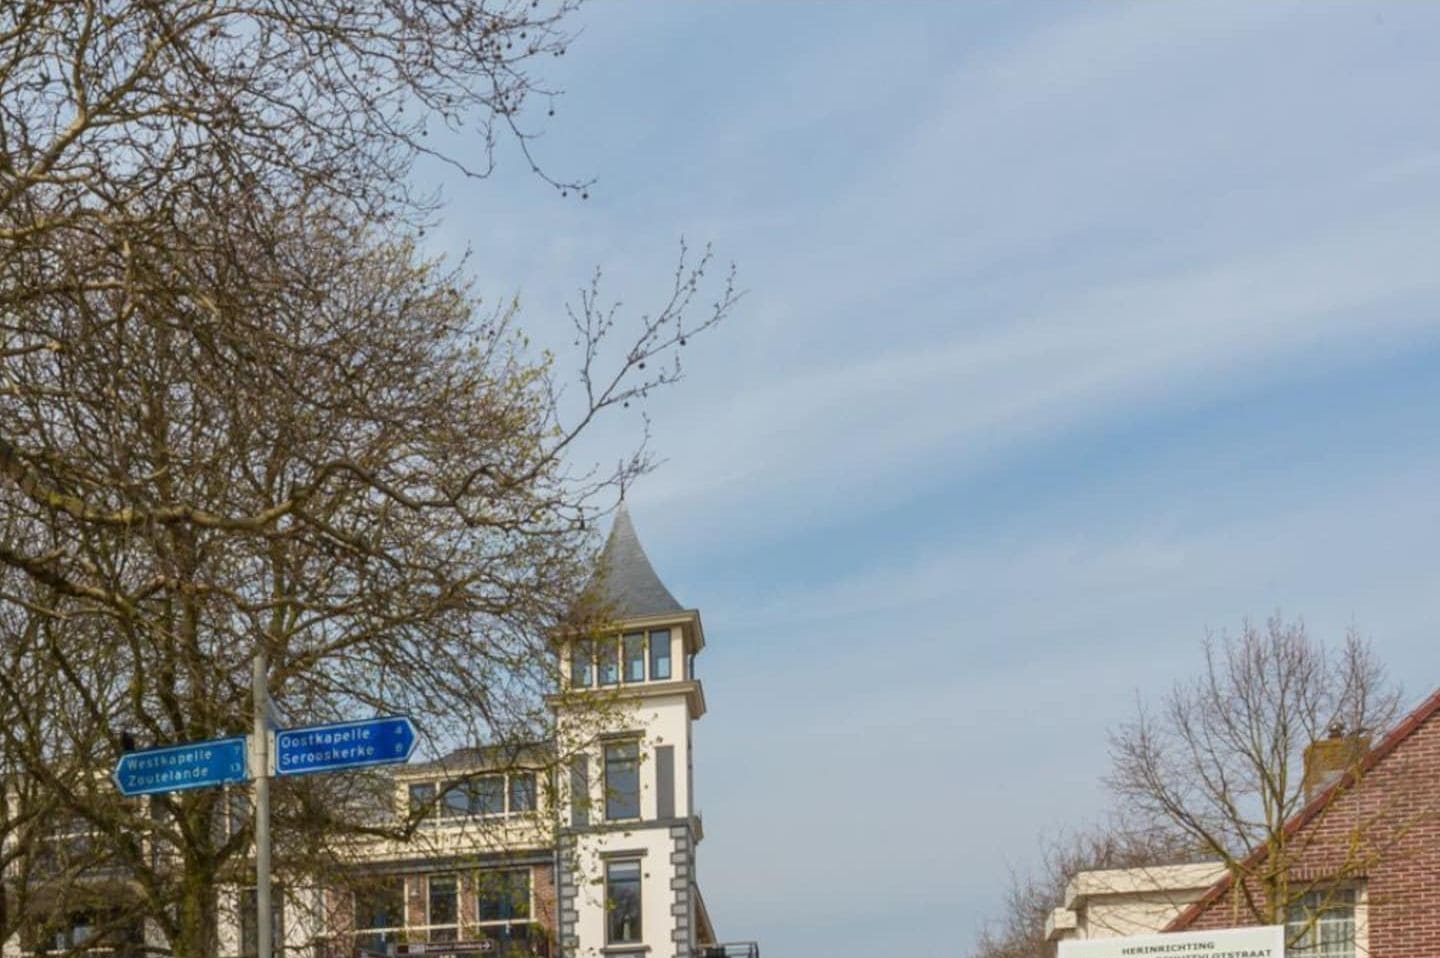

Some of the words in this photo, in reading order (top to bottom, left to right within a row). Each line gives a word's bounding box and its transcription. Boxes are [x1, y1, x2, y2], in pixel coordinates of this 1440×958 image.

[281, 728, 371, 748] Oostkapelle
[127, 749, 212, 770] Westkapelle
[281, 744, 375, 765] Serooskerke
[127, 766, 209, 787] Zoutelande
[1122, 942, 1215, 955] HERINRICHTING
